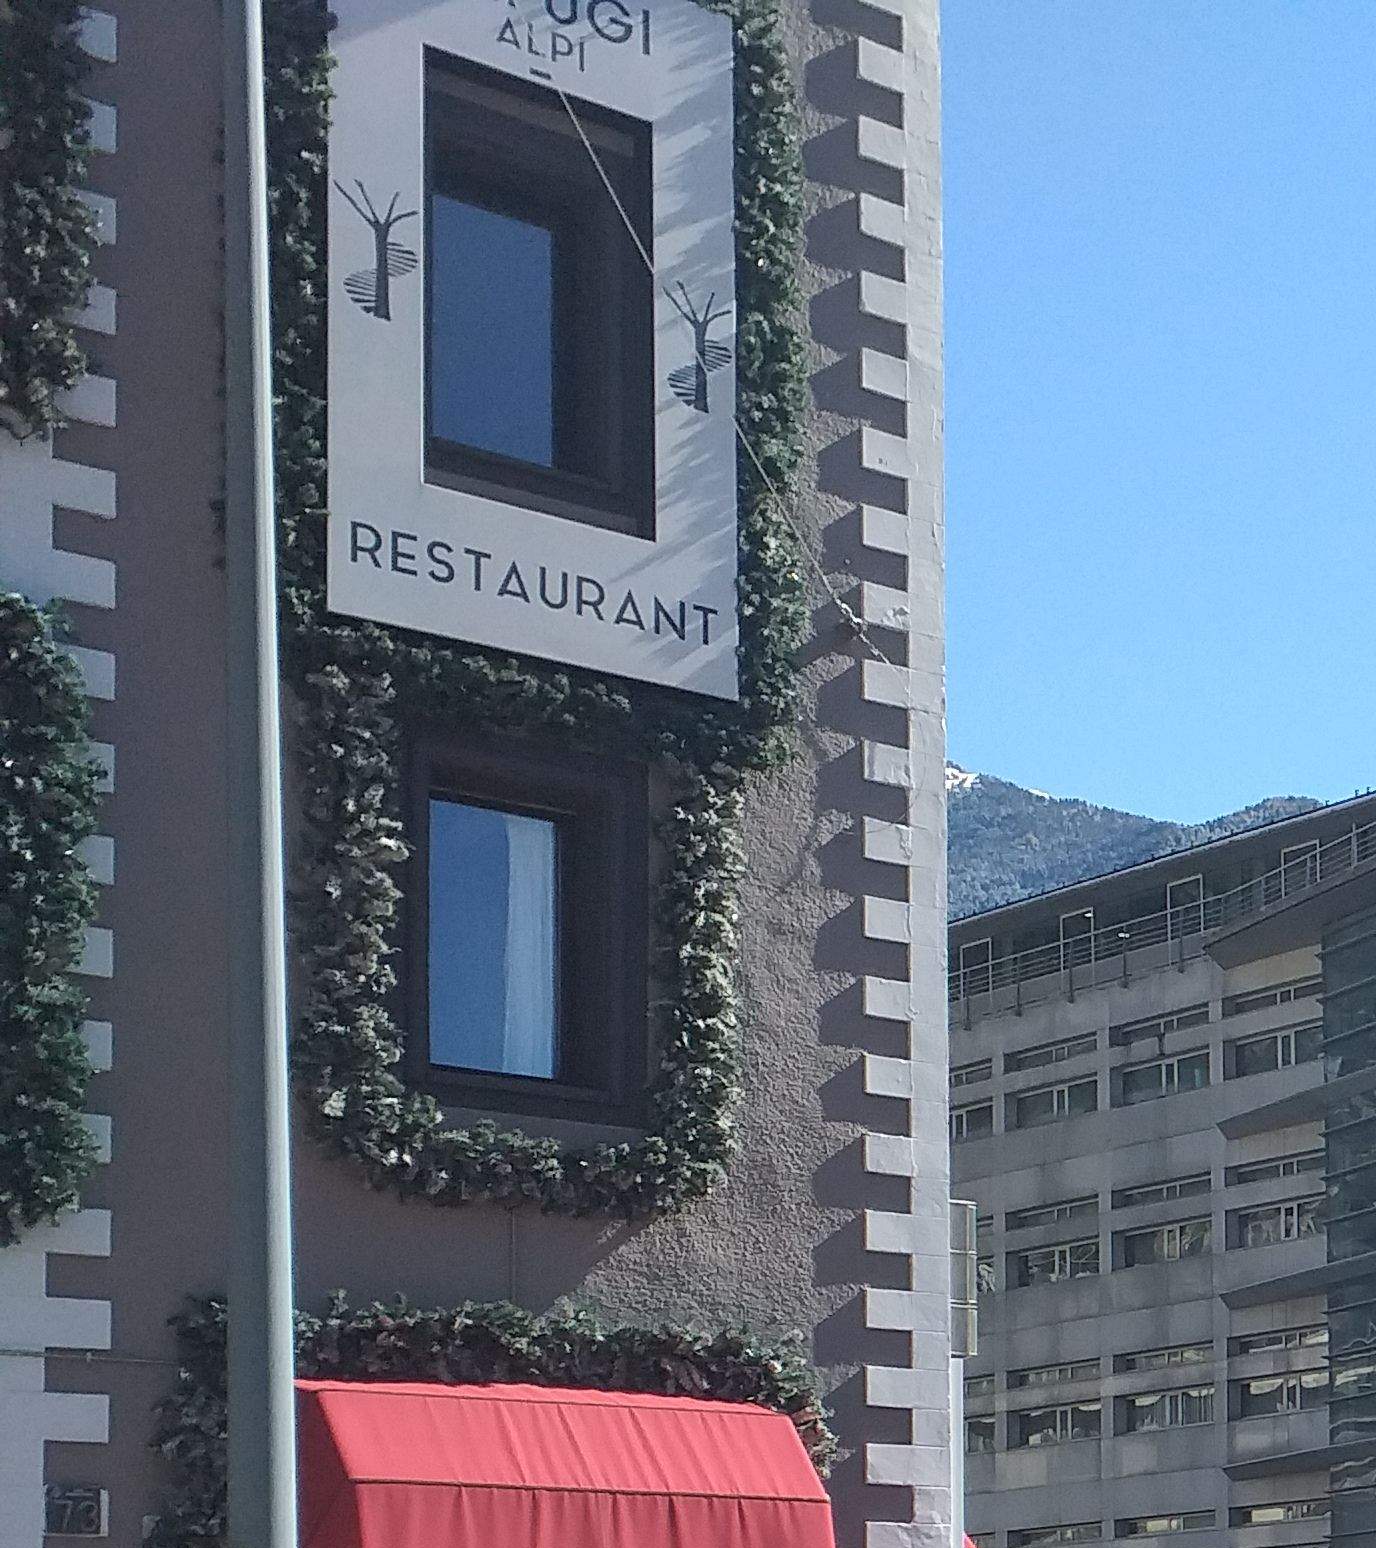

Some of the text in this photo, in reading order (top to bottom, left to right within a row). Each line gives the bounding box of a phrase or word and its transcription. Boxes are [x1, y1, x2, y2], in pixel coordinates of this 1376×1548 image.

[497, 17, 585, 72] ALPI
[507, 0, 650, 55] UGI
[349, 520, 719, 646] RESTAURANT
